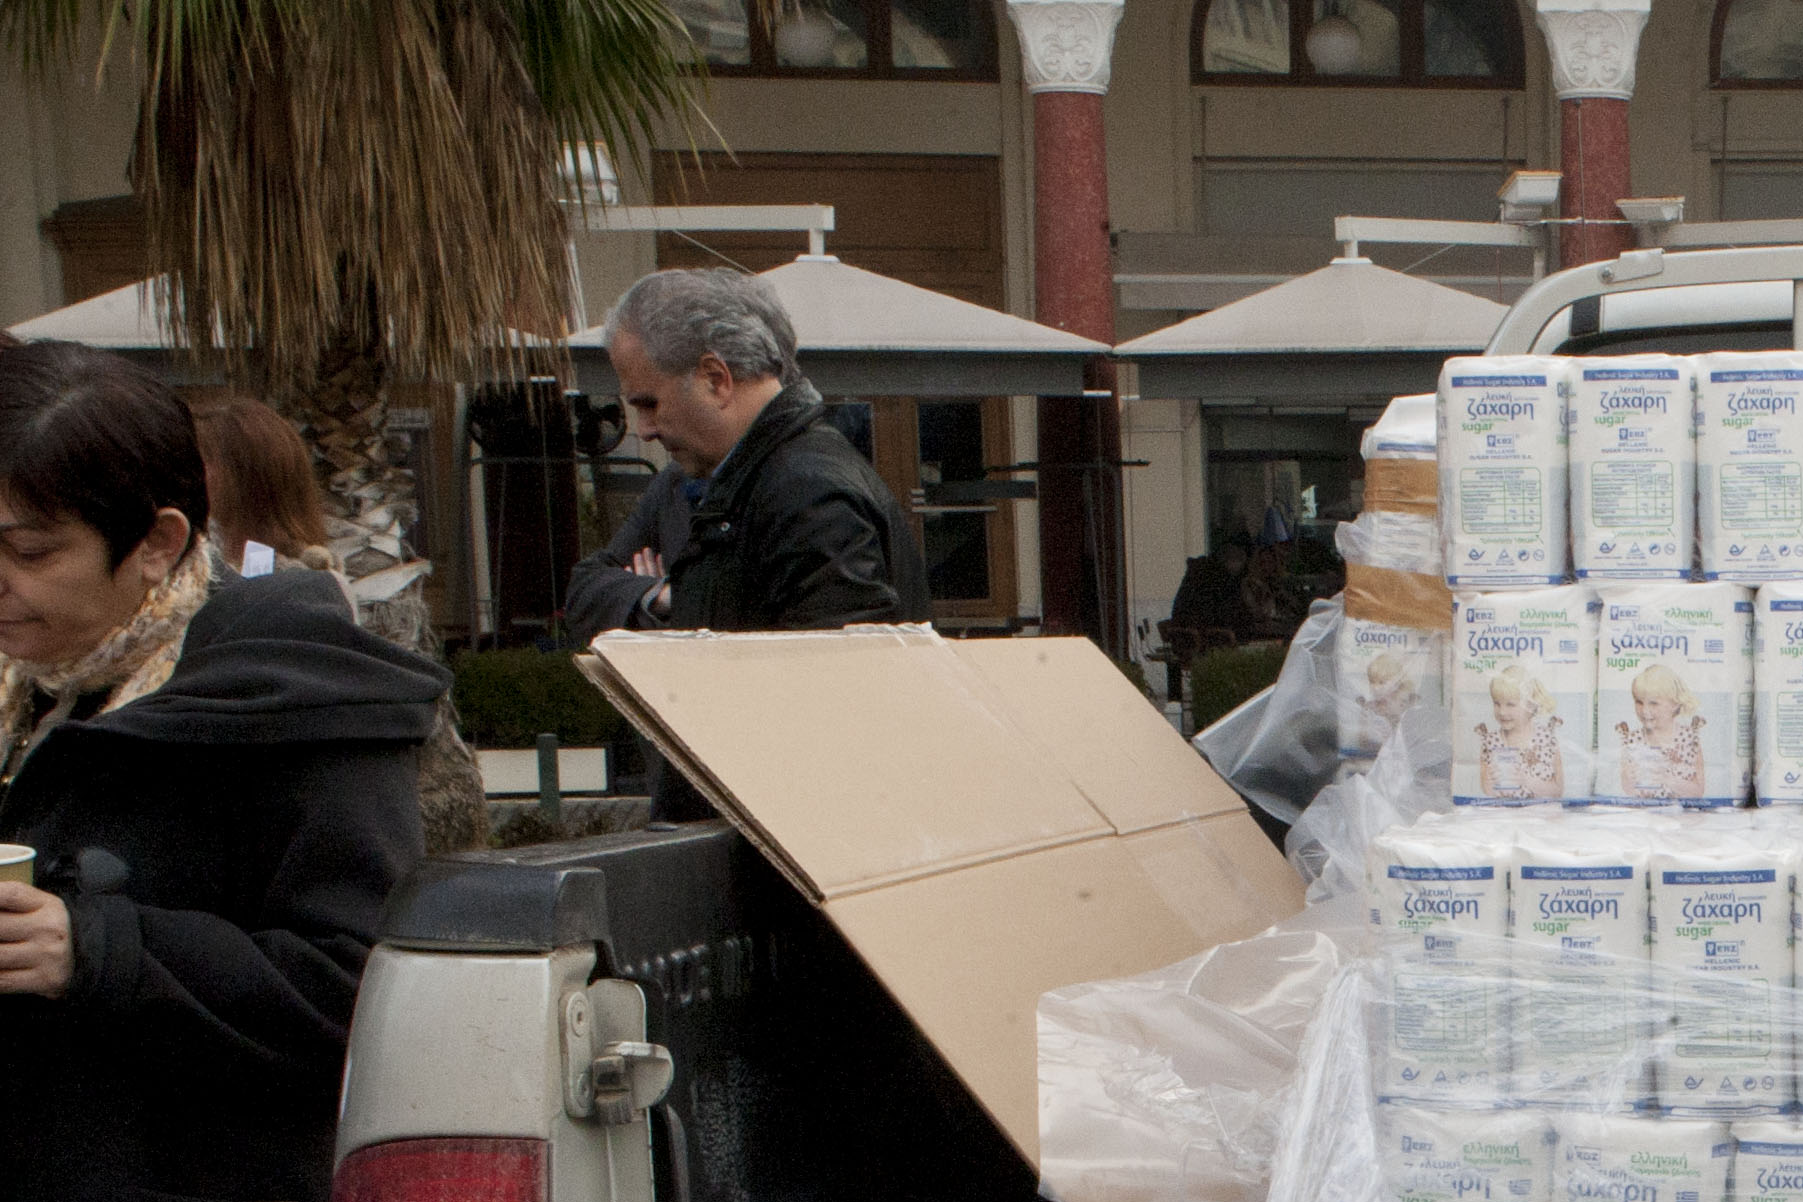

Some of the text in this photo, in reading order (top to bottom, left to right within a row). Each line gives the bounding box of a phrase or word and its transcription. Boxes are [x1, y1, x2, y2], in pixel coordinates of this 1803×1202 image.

[1467, 399, 1534, 421] ζάχαρη
[1600, 391, 1667, 414] ζάχαρη
[1727, 392, 1795, 414] ζάχαρη
[1467, 629, 1543, 656] ζάχαρη
[1606, 655, 1640, 671] sugar
[1404, 895, 1478, 919] ζάχαρη
[1539, 893, 1618, 919] ζάχαρη
[1683, 897, 1761, 923] ζάχαρη
[1533, 919, 1569, 937] sugar
[1676, 924, 1714, 940] sugar
